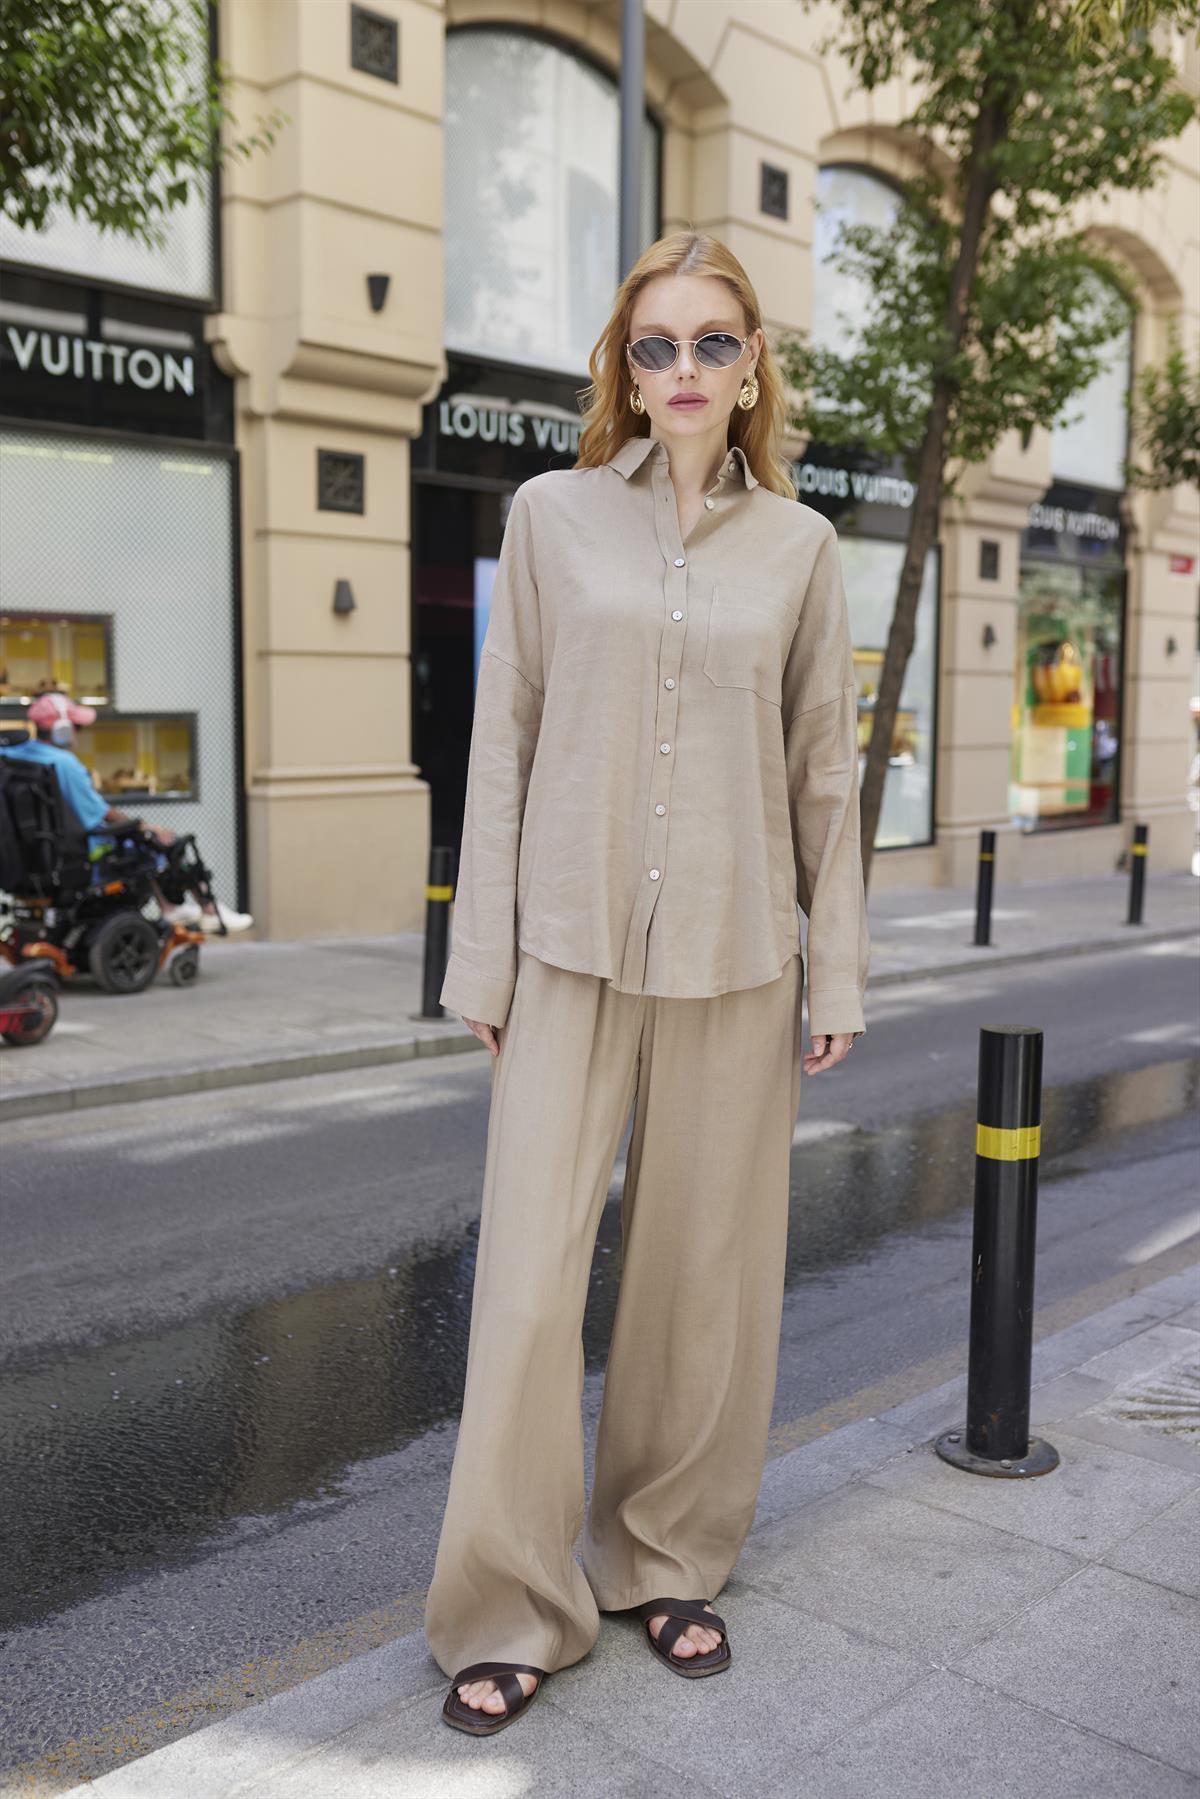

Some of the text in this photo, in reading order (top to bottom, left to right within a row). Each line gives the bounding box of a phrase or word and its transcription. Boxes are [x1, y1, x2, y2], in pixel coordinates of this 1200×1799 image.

[7, 327, 194, 396] VUITTON
[439, 402, 584, 455] LOUIS VUI
[850, 472, 918, 508] VUITTO
[1029, 502, 1065, 532] OUIS
